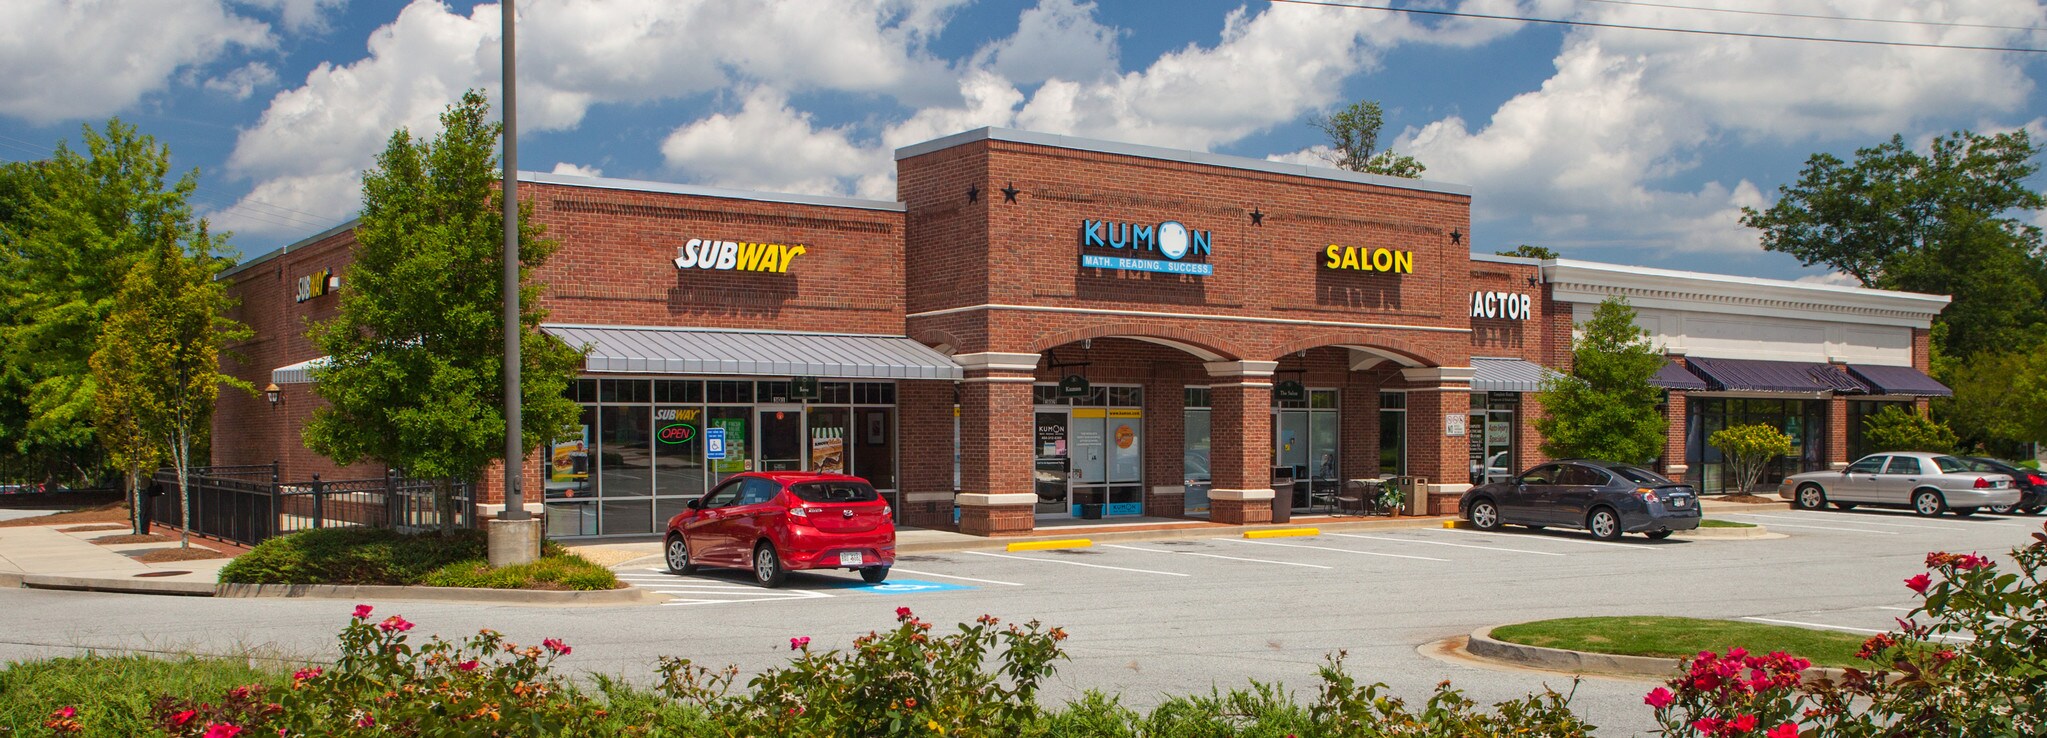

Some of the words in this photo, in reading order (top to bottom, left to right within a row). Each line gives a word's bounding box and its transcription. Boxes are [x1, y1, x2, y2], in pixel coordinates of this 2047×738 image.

[1084, 219, 1212, 260] KUMON
[675, 239, 806, 273] SUBWAY
[1085, 255, 1113, 267] MATH.
[1119, 258, 1162, 270] READING.
[1168, 262, 1211, 274] SUCCESS.
[1326, 244, 1413, 274] SALON
[296, 267, 328, 302] SUBWAY
[1470, 290, 1531, 320] ACTOR
[655, 409, 700, 420] SUBWAY
[661, 428, 690, 439] OPEN
[1039, 425, 1065, 433] KUMON
[1113, 503, 1136, 511] KUMON
